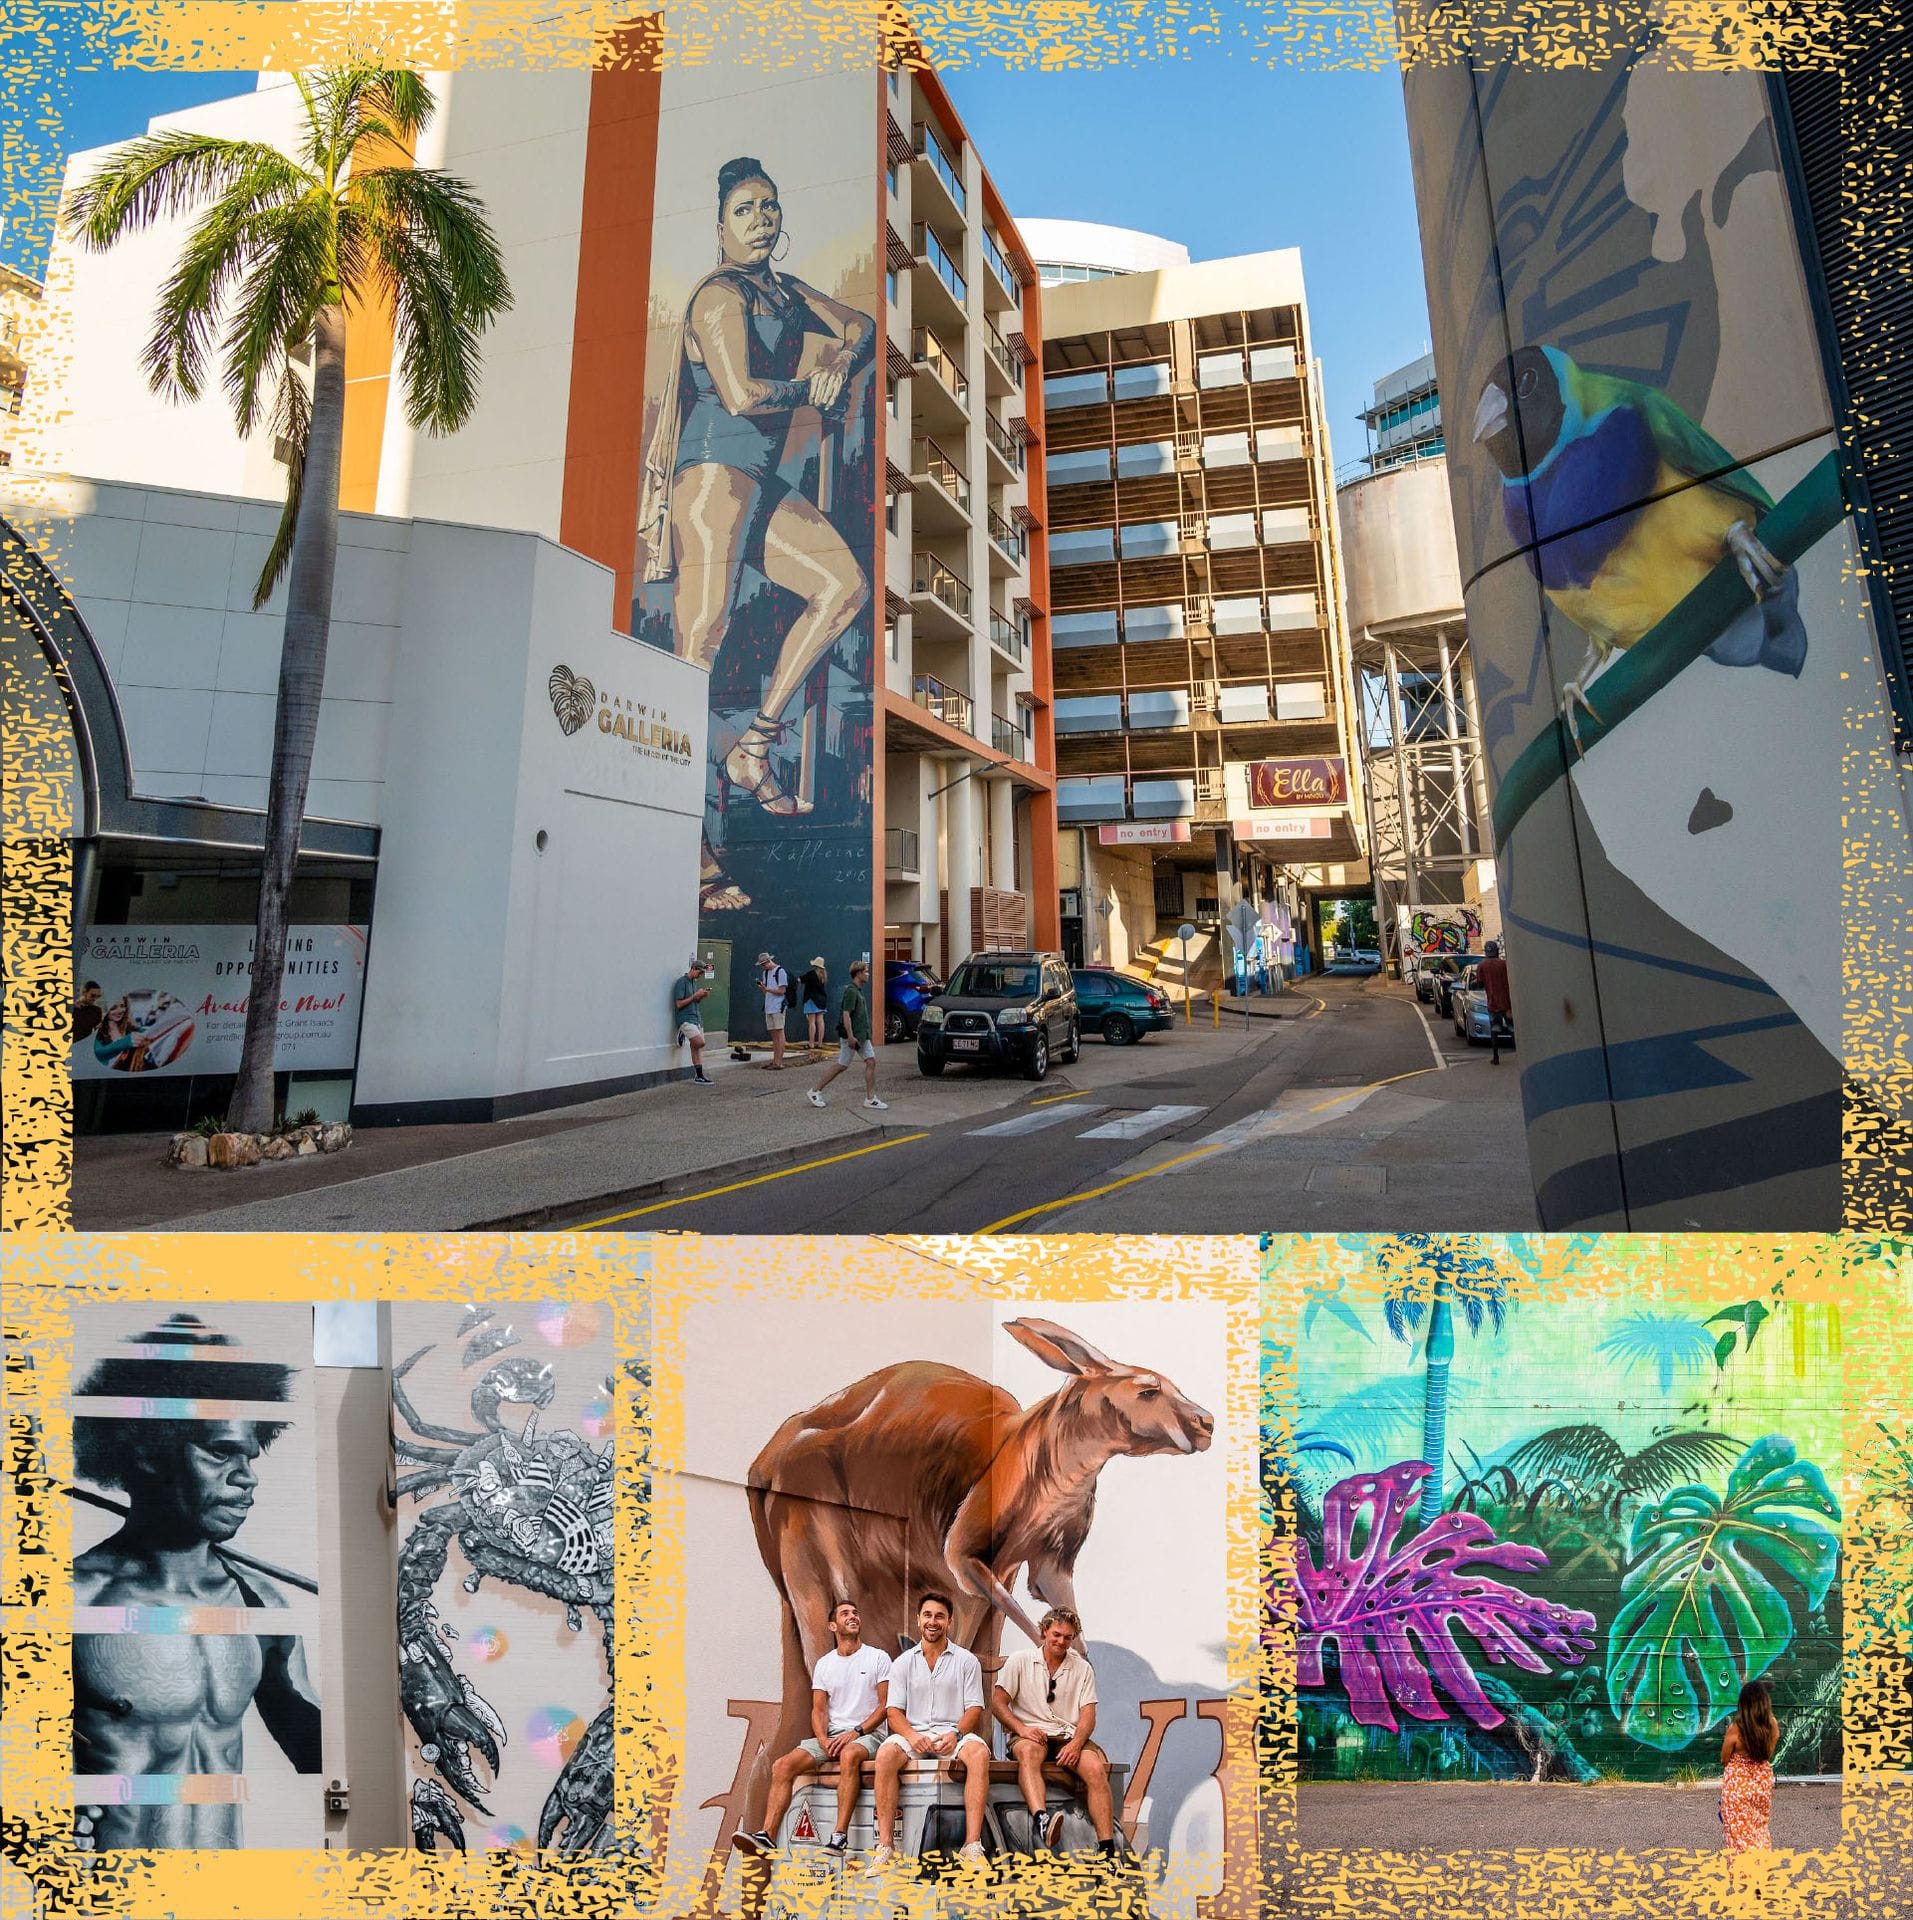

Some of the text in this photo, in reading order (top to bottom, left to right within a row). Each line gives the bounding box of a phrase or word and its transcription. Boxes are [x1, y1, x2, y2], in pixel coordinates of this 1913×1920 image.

[600, 691, 667, 722] DARWIN
[598, 709, 691, 757] GALLERIA
[1273, 768, 1325, 798] Ella
[1120, 827, 1168, 839] no entry
[1256, 823, 1306, 834] no entry
[96, 936, 170, 944] DARWIN
[248, 938, 313, 952] LING
[92, 944, 200, 960] GALLERIA
[216, 960, 339, 976] OPPONITIES
[195, 993, 345, 1015] Availe Now!
[206, 1021, 219, 1029] For
[285, 1019, 308, 1027] Grant
